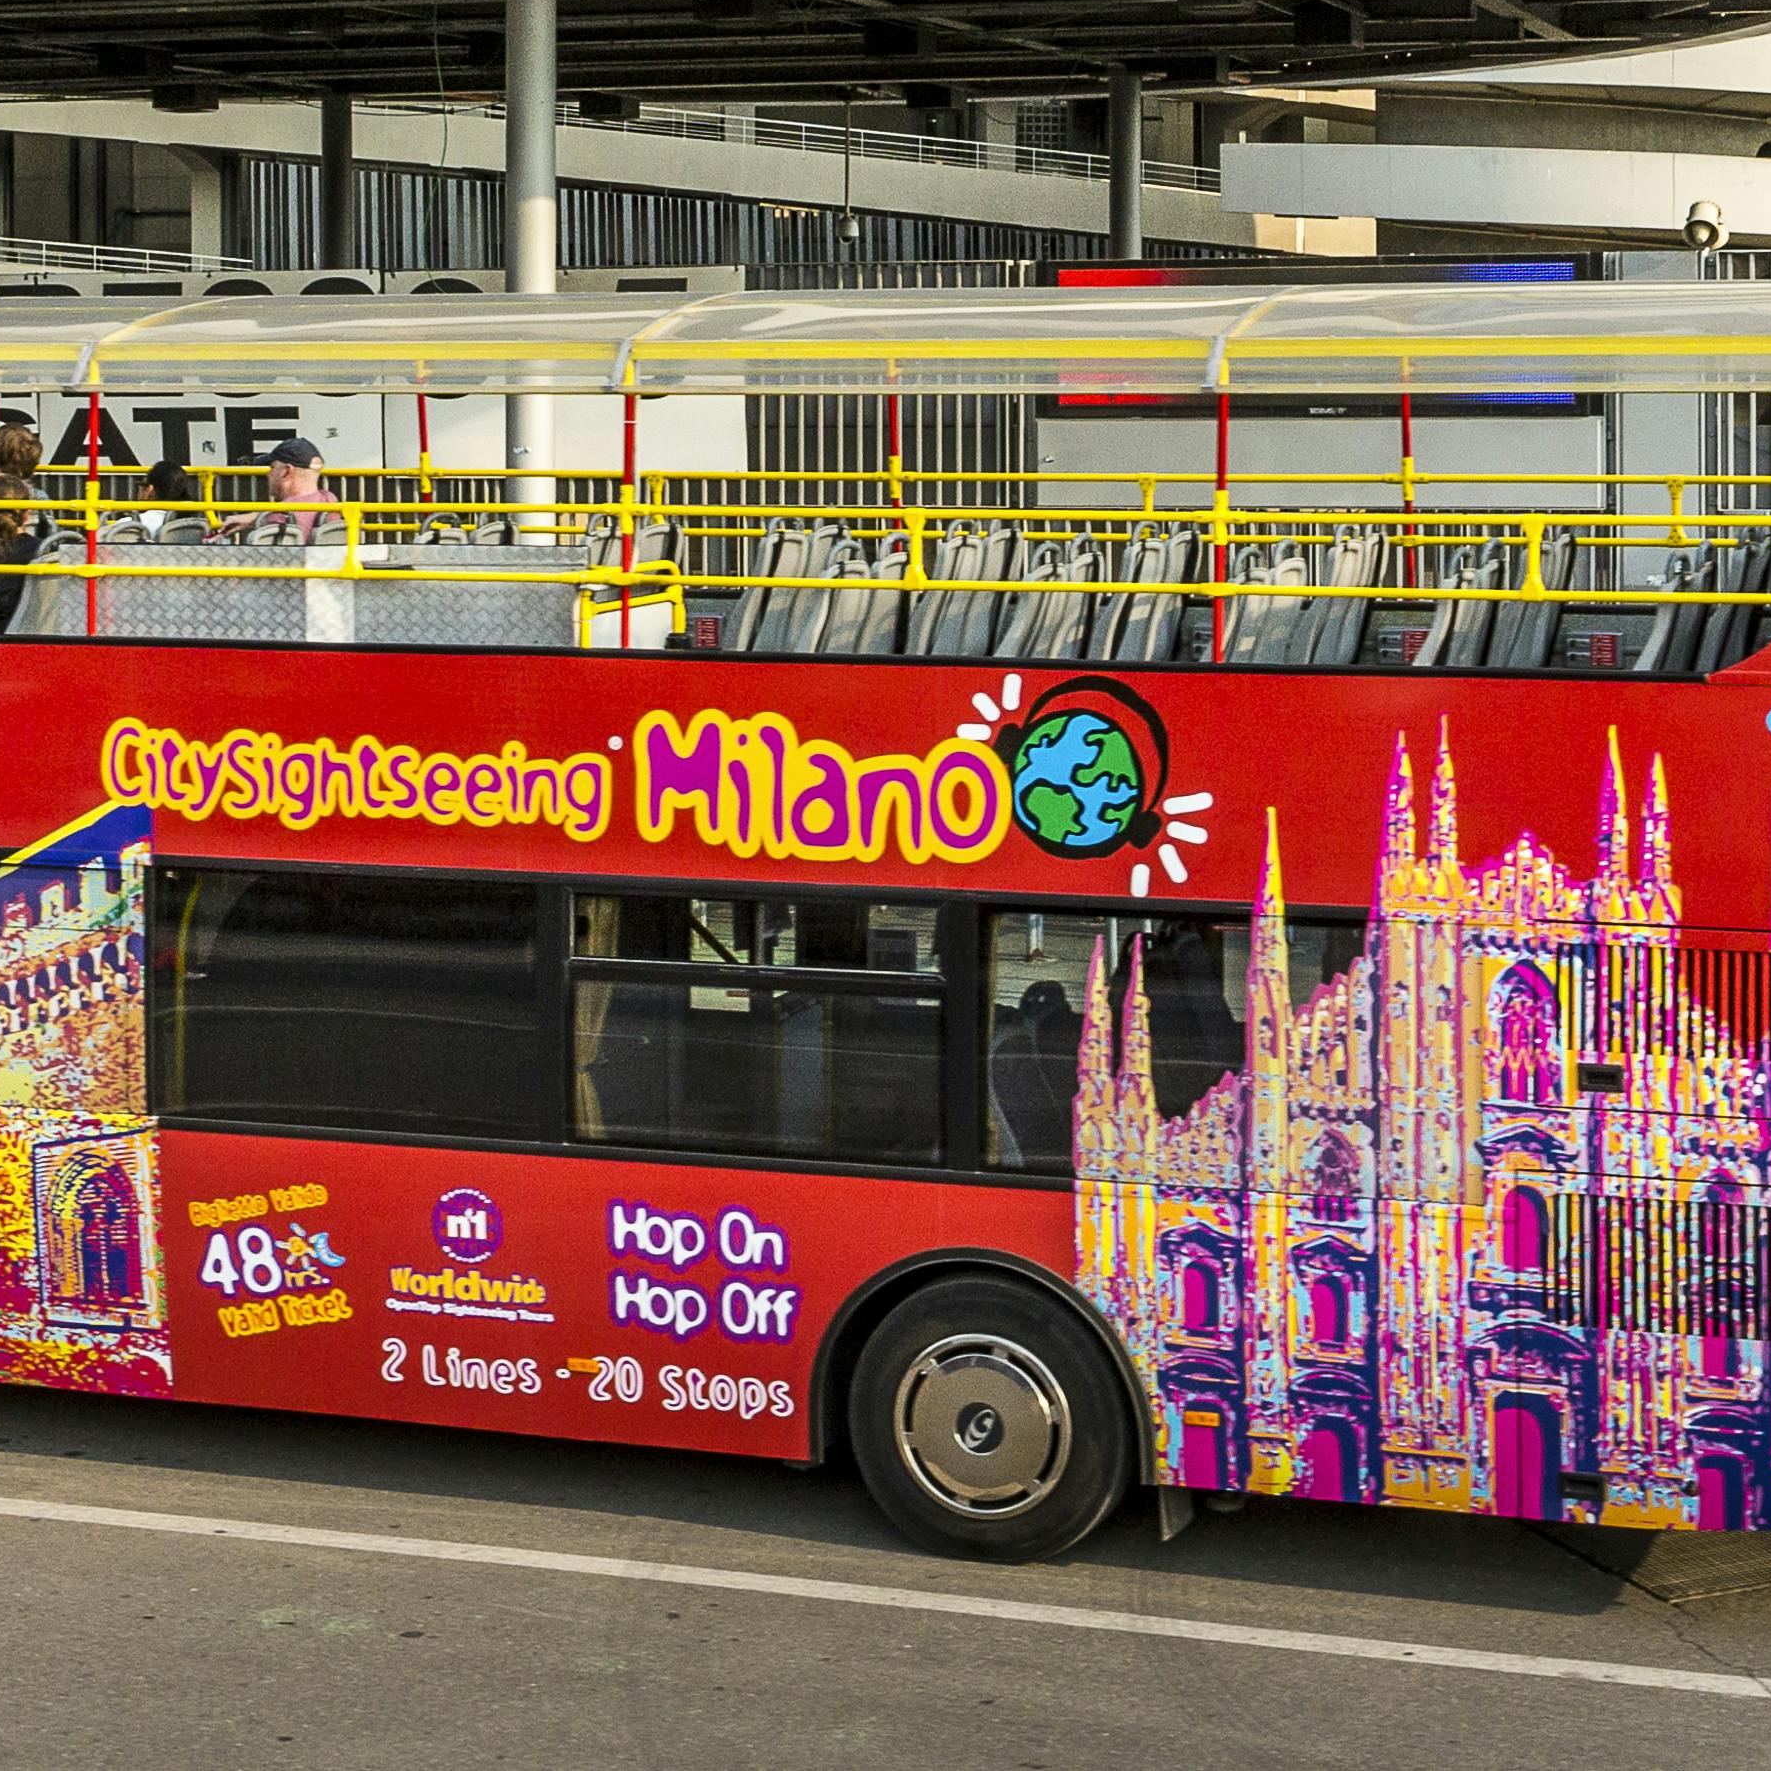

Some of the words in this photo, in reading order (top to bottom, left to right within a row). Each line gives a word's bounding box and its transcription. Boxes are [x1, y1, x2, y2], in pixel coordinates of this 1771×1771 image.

[633, 709, 1012, 863] Milano
[201, 1227, 282, 1295] 48
[612, 1204, 706, 1266] Hop
[719, 1211, 786, 1266] On
[218, 1299, 281, 1338] Valid
[277, 1288, 354, 1326] Ticket
[390, 1267, 547, 1304] Worldwide
[615, 1275, 707, 1336] Hop
[721, 1282, 797, 1337] Off
[382, 1338, 406, 1383] 2
[422, 1344, 542, 1395] Lines
[588, 1355, 643, 1403] 20
[658, 1366, 795, 1420] Stops
